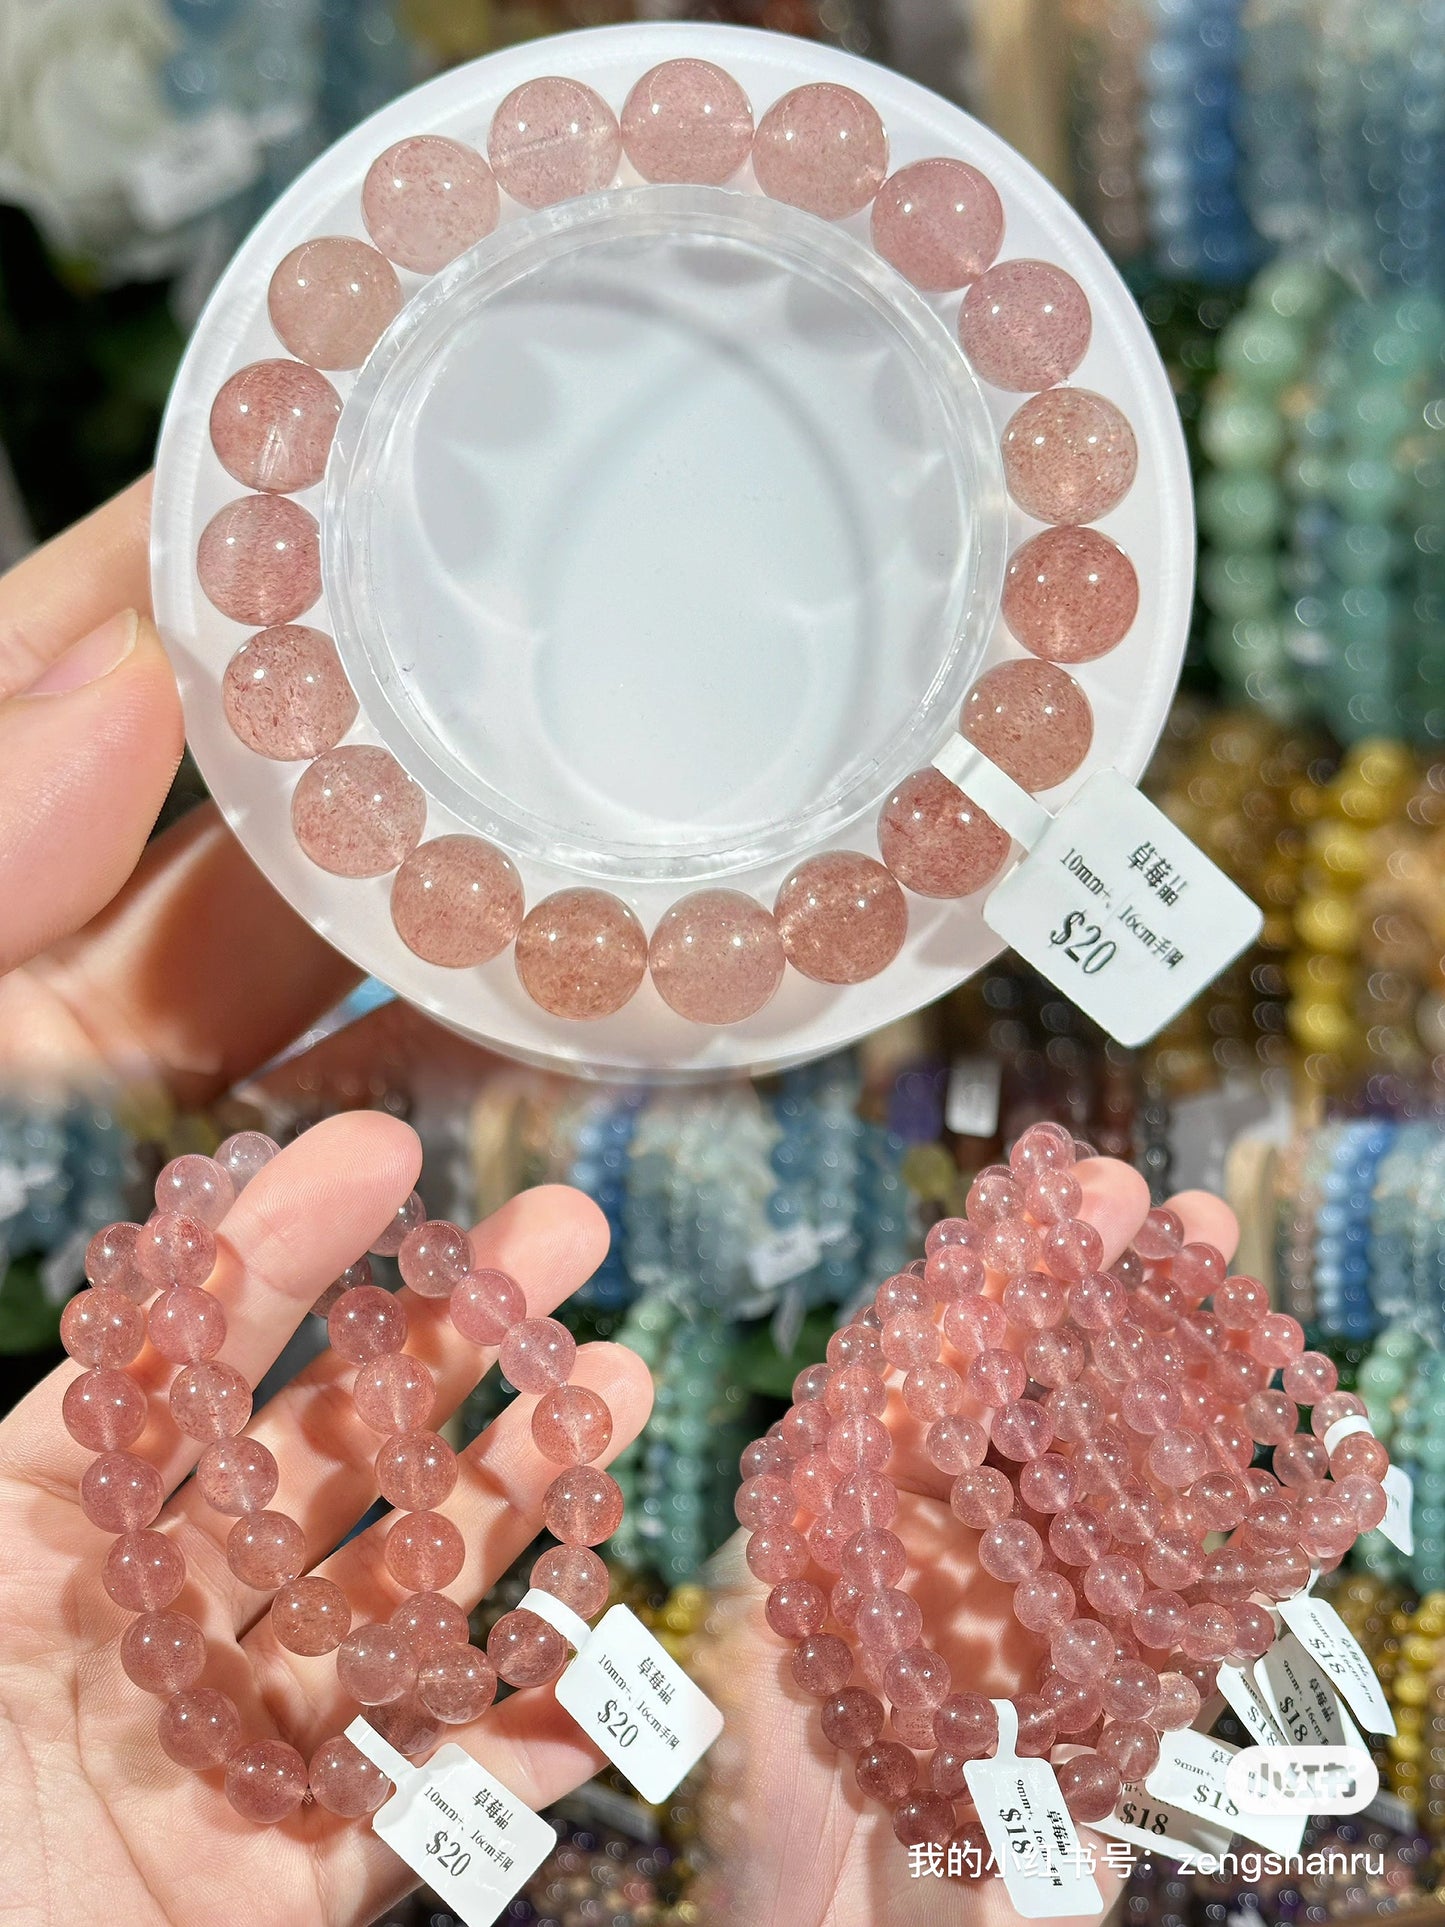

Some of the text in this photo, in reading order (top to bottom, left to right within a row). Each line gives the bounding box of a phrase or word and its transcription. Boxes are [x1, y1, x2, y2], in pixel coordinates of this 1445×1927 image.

[1049, 909, 1117, 974] $20
[1308, 1638, 1346, 1674] $18
[597, 1698, 639, 1748] $20
[1247, 1706, 1278, 1746] $18
[1280, 1696, 1308, 1742] $18
[999, 1808, 1035, 1854] $18
[1119, 1801, 1169, 1835] $18
[425, 1829, 472, 1877] $20
